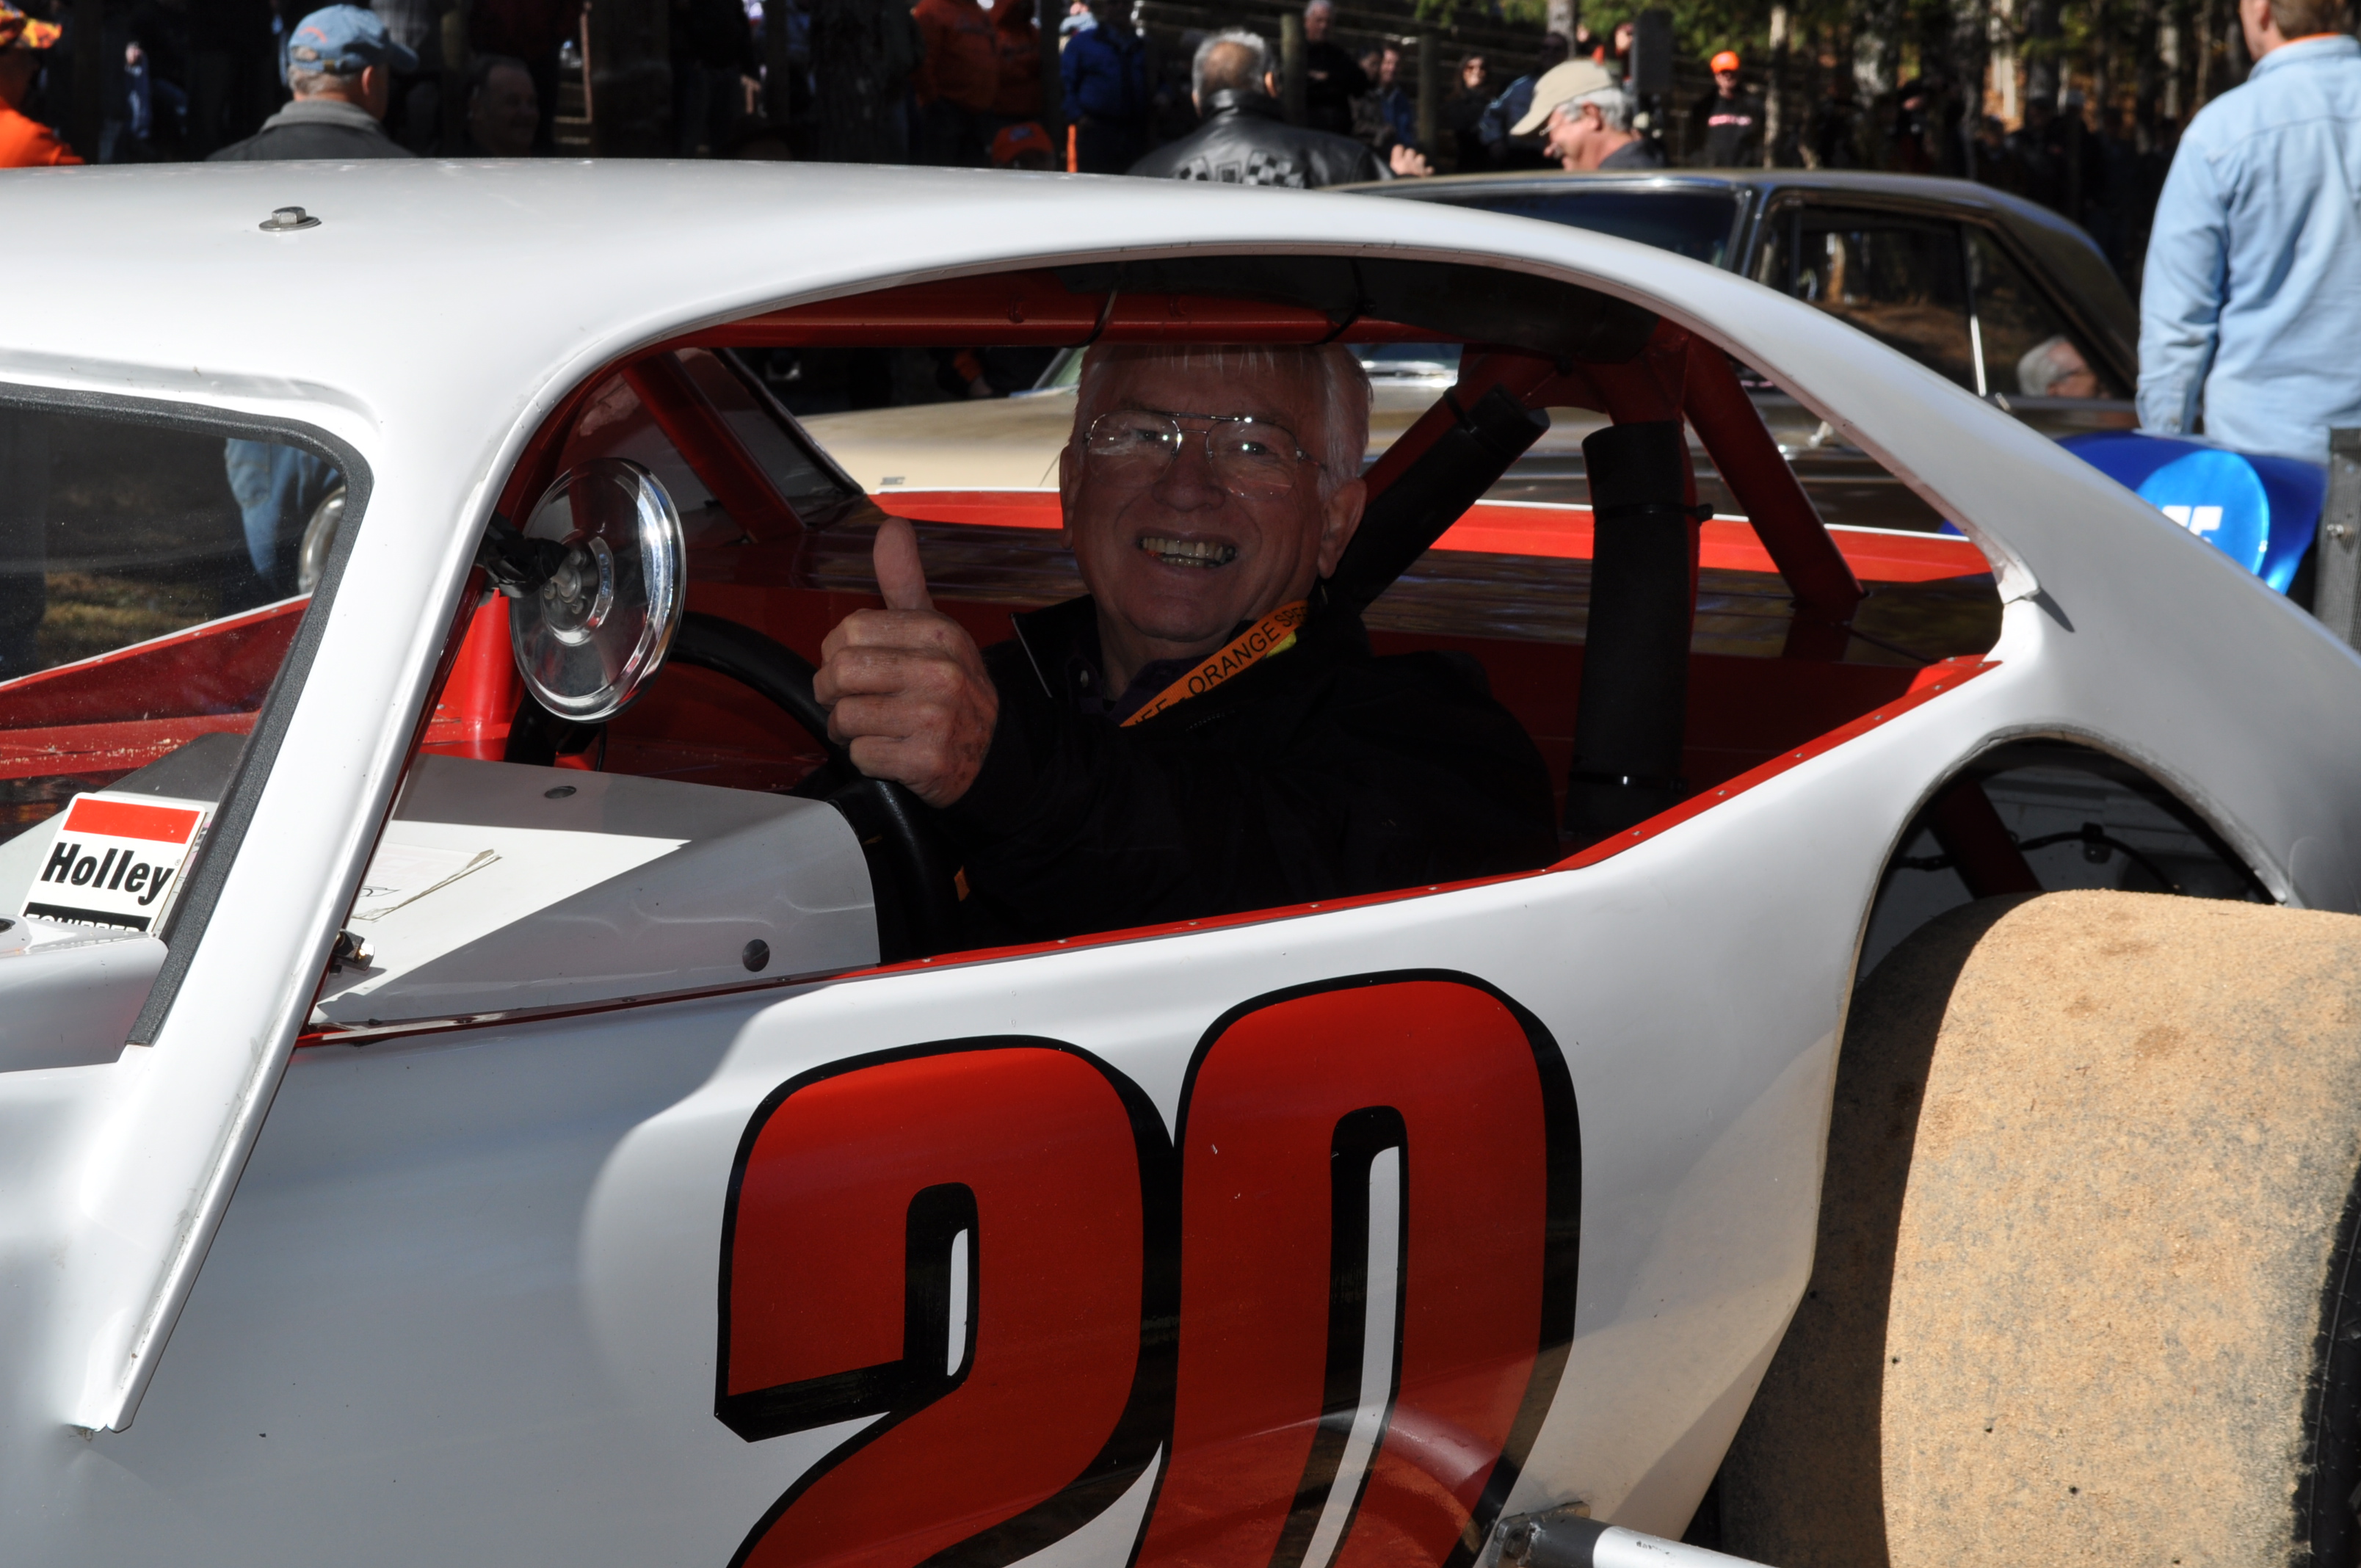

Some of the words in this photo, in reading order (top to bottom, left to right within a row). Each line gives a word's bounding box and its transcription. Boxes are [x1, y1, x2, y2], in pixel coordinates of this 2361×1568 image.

[1188, 622, 1280, 696] ORANGE
[40, 841, 175, 906] Holley
[714, 968, 1582, 1568] 20
